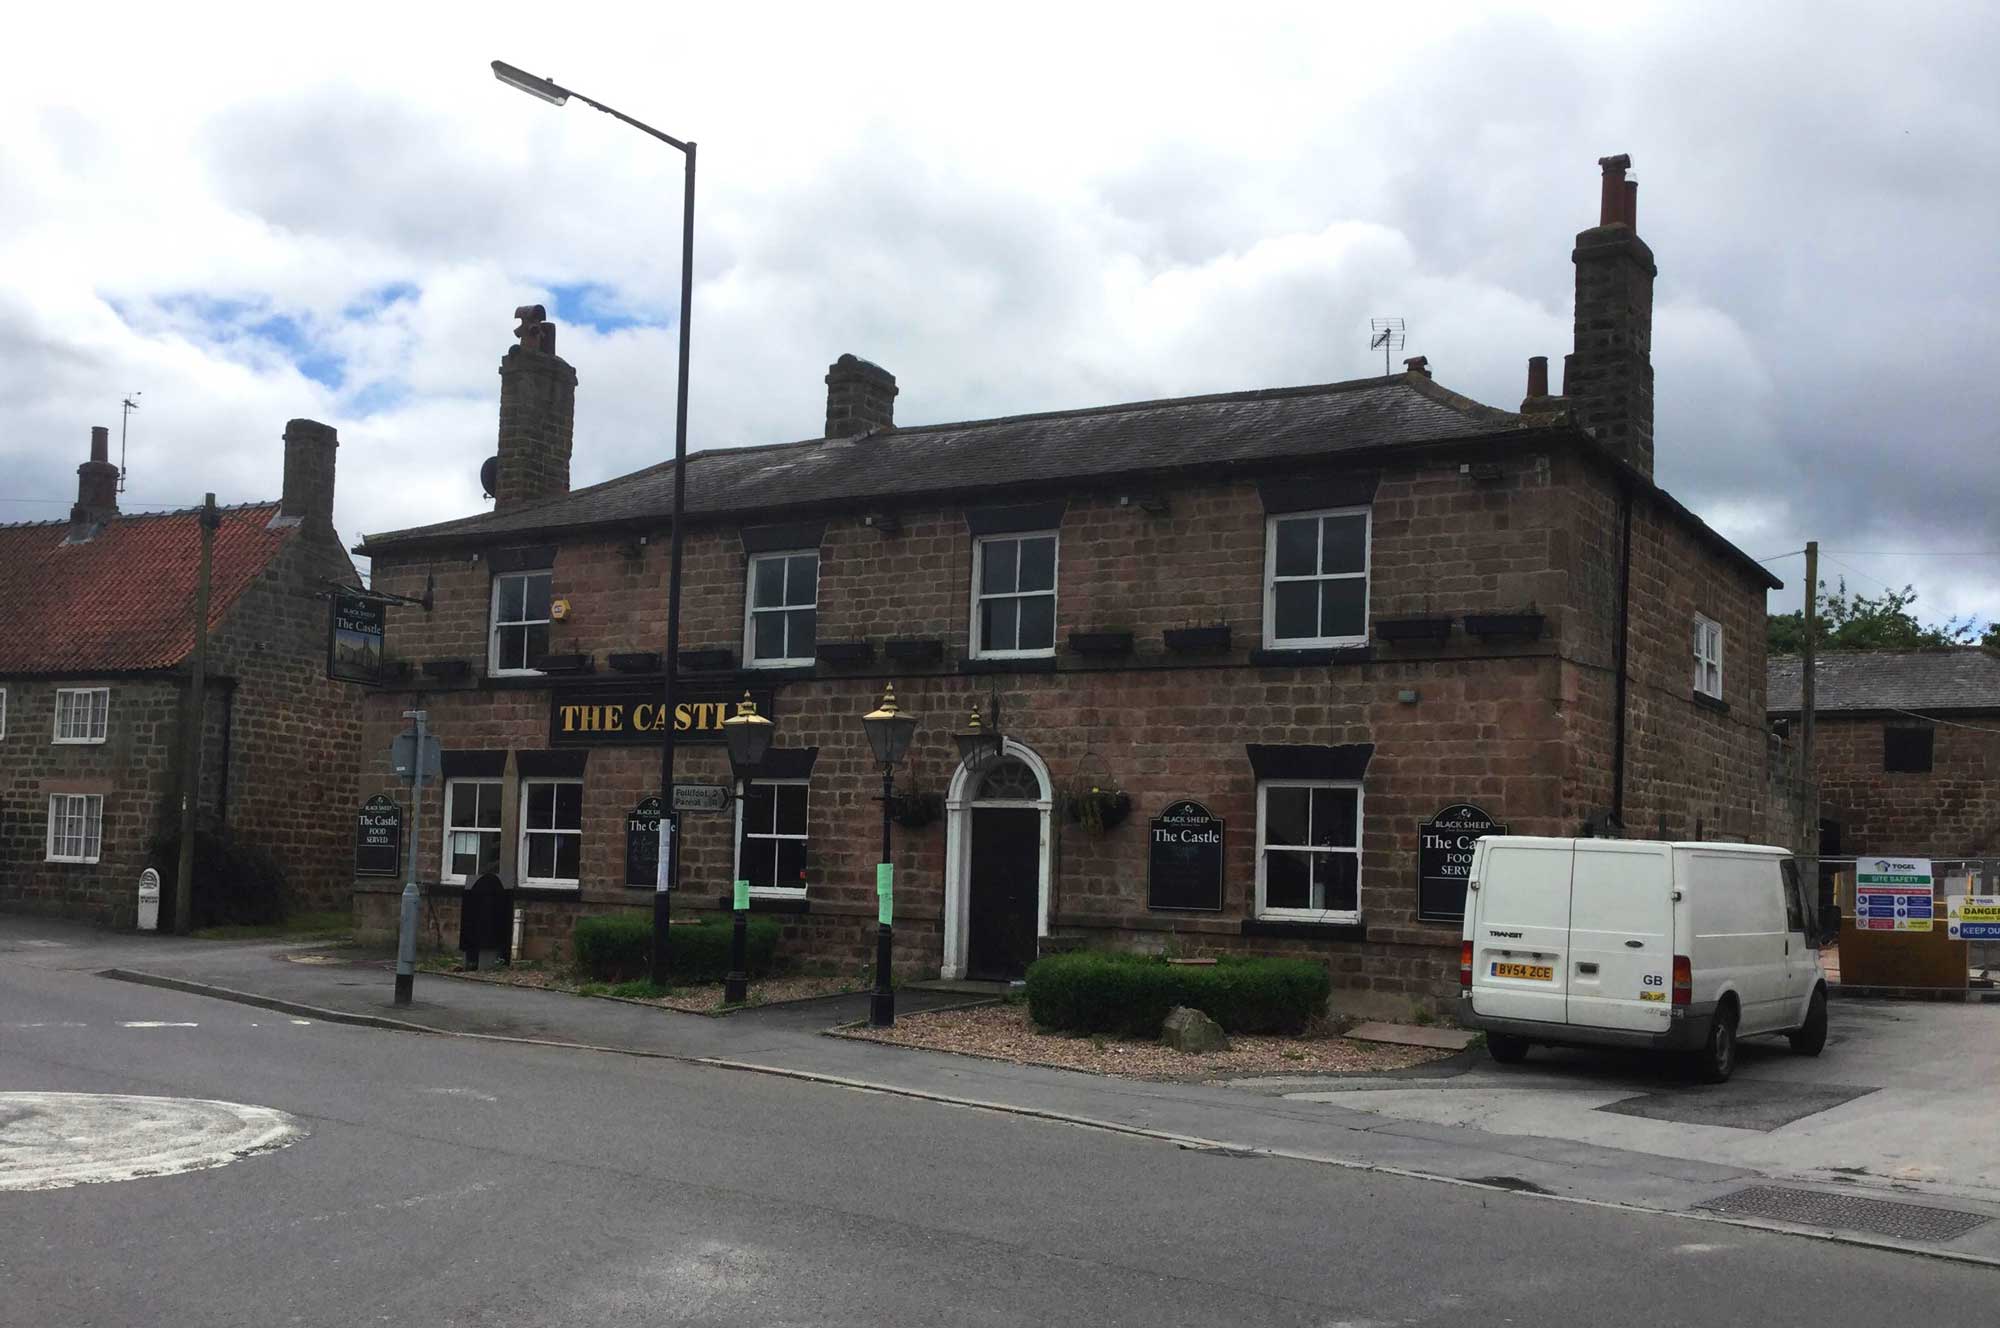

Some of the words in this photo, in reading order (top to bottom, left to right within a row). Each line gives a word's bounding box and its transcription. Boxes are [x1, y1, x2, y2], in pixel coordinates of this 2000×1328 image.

[336, 617, 353, 629] The
[356, 621, 381, 634] Castle
[560, 705, 623, 731] THE
[676, 789, 708, 797] Follifoot
[360, 815, 373, 826] The
[374, 815, 398, 826] Castle
[630, 820, 646, 831] The
[1464, 821, 1491, 829] SHEEP
[1152, 828, 1177, 842] The
[1181, 829, 1220, 843] Castle
[1422, 834, 1452, 849] The
[1447, 853, 1472, 863] FOO
[1441, 865, 1470, 875] SERV
[1890, 875, 1919, 883] SAFETY
[1489, 930, 1523, 939] TRANSIT
[1963, 927, 1986, 935] KEEP
[1499, 963, 1527, 976] BV54
[1529, 966, 1551, 978] ZCE
[1643, 974, 1663, 986] GB
